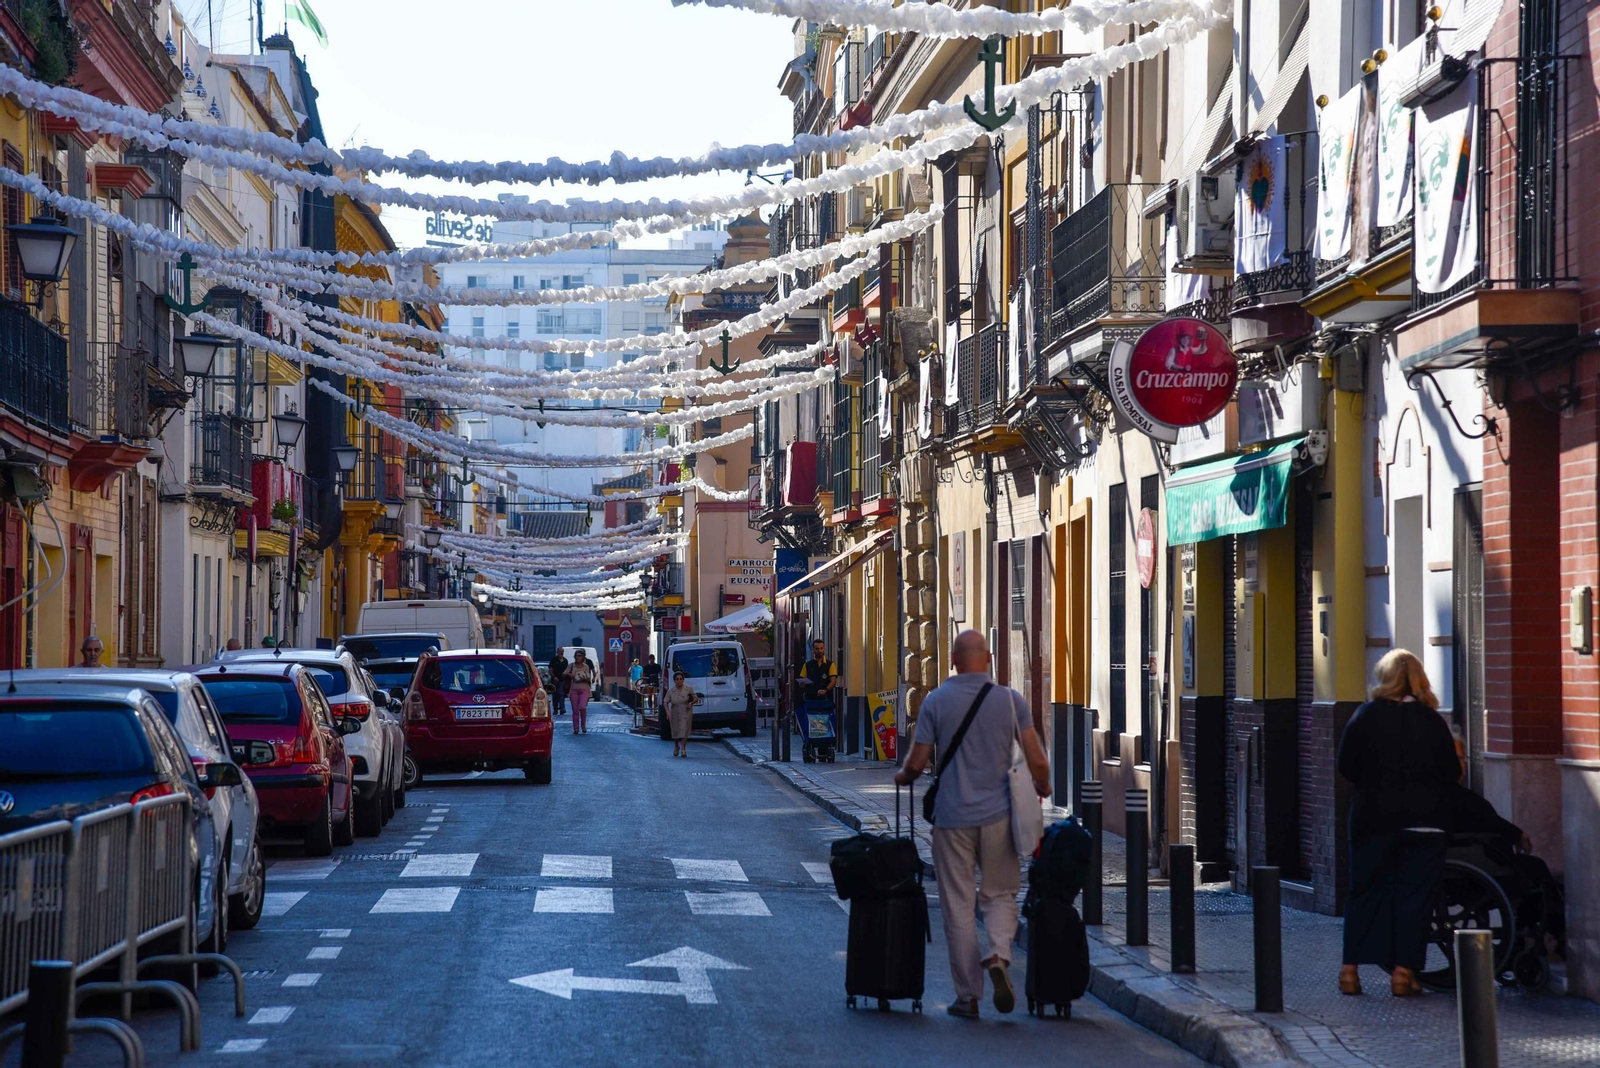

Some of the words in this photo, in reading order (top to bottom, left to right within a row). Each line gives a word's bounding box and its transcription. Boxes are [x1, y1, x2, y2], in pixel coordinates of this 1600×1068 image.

[1136, 370, 1229, 391] Cruzcampo
[1114, 367, 1125, 395] CASA
[1120, 395, 1154, 433] REMESAL
[1181, 395, 1203, 404] 1904
[461, 709, 482, 718] 7823
[484, 709, 500, 718] FTY
